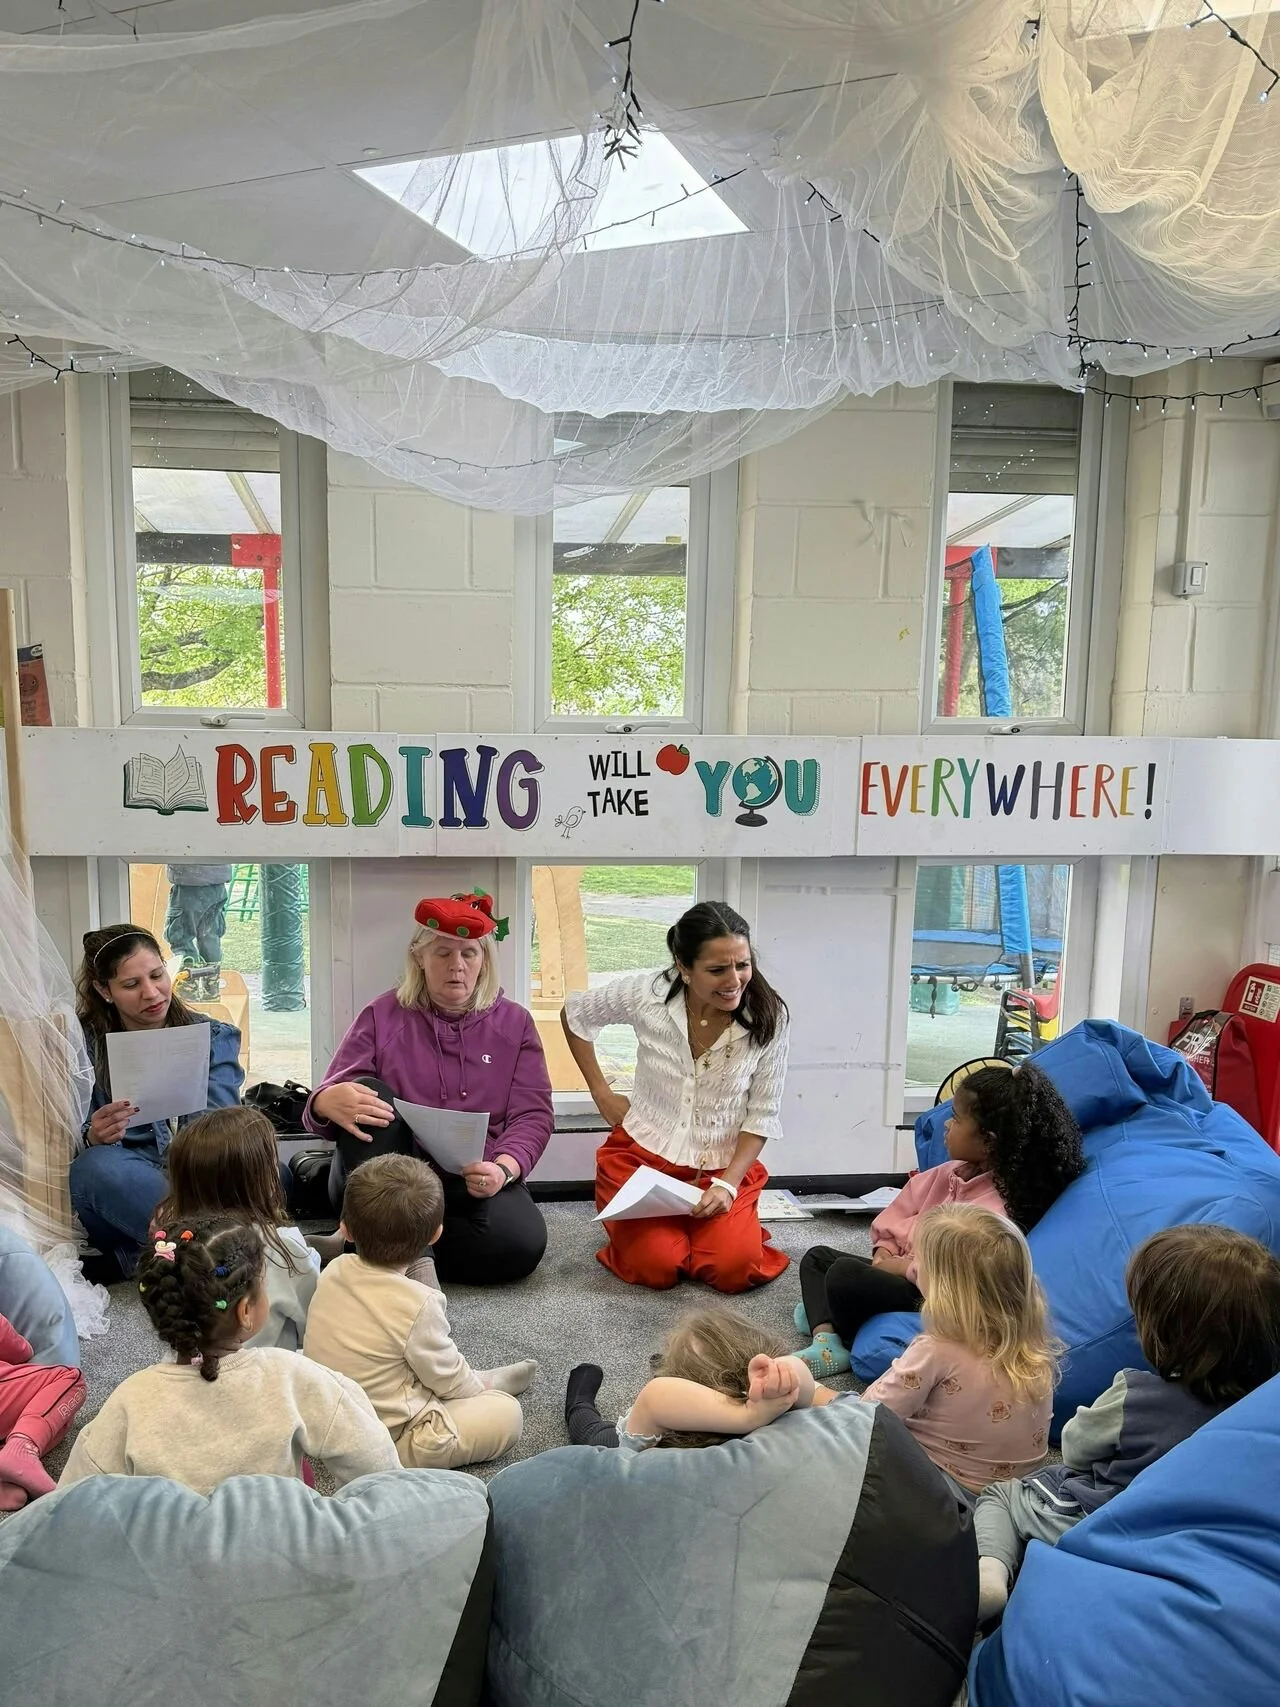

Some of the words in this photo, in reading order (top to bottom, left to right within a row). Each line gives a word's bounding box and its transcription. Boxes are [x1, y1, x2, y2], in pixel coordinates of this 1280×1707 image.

[215, 743, 546, 831] READING
[588, 750, 651, 781] WILL
[587, 787, 649, 817] TAKE
[694, 756, 821, 828] YOU
[861, 758, 1157, 820] EVERYWHERE!
